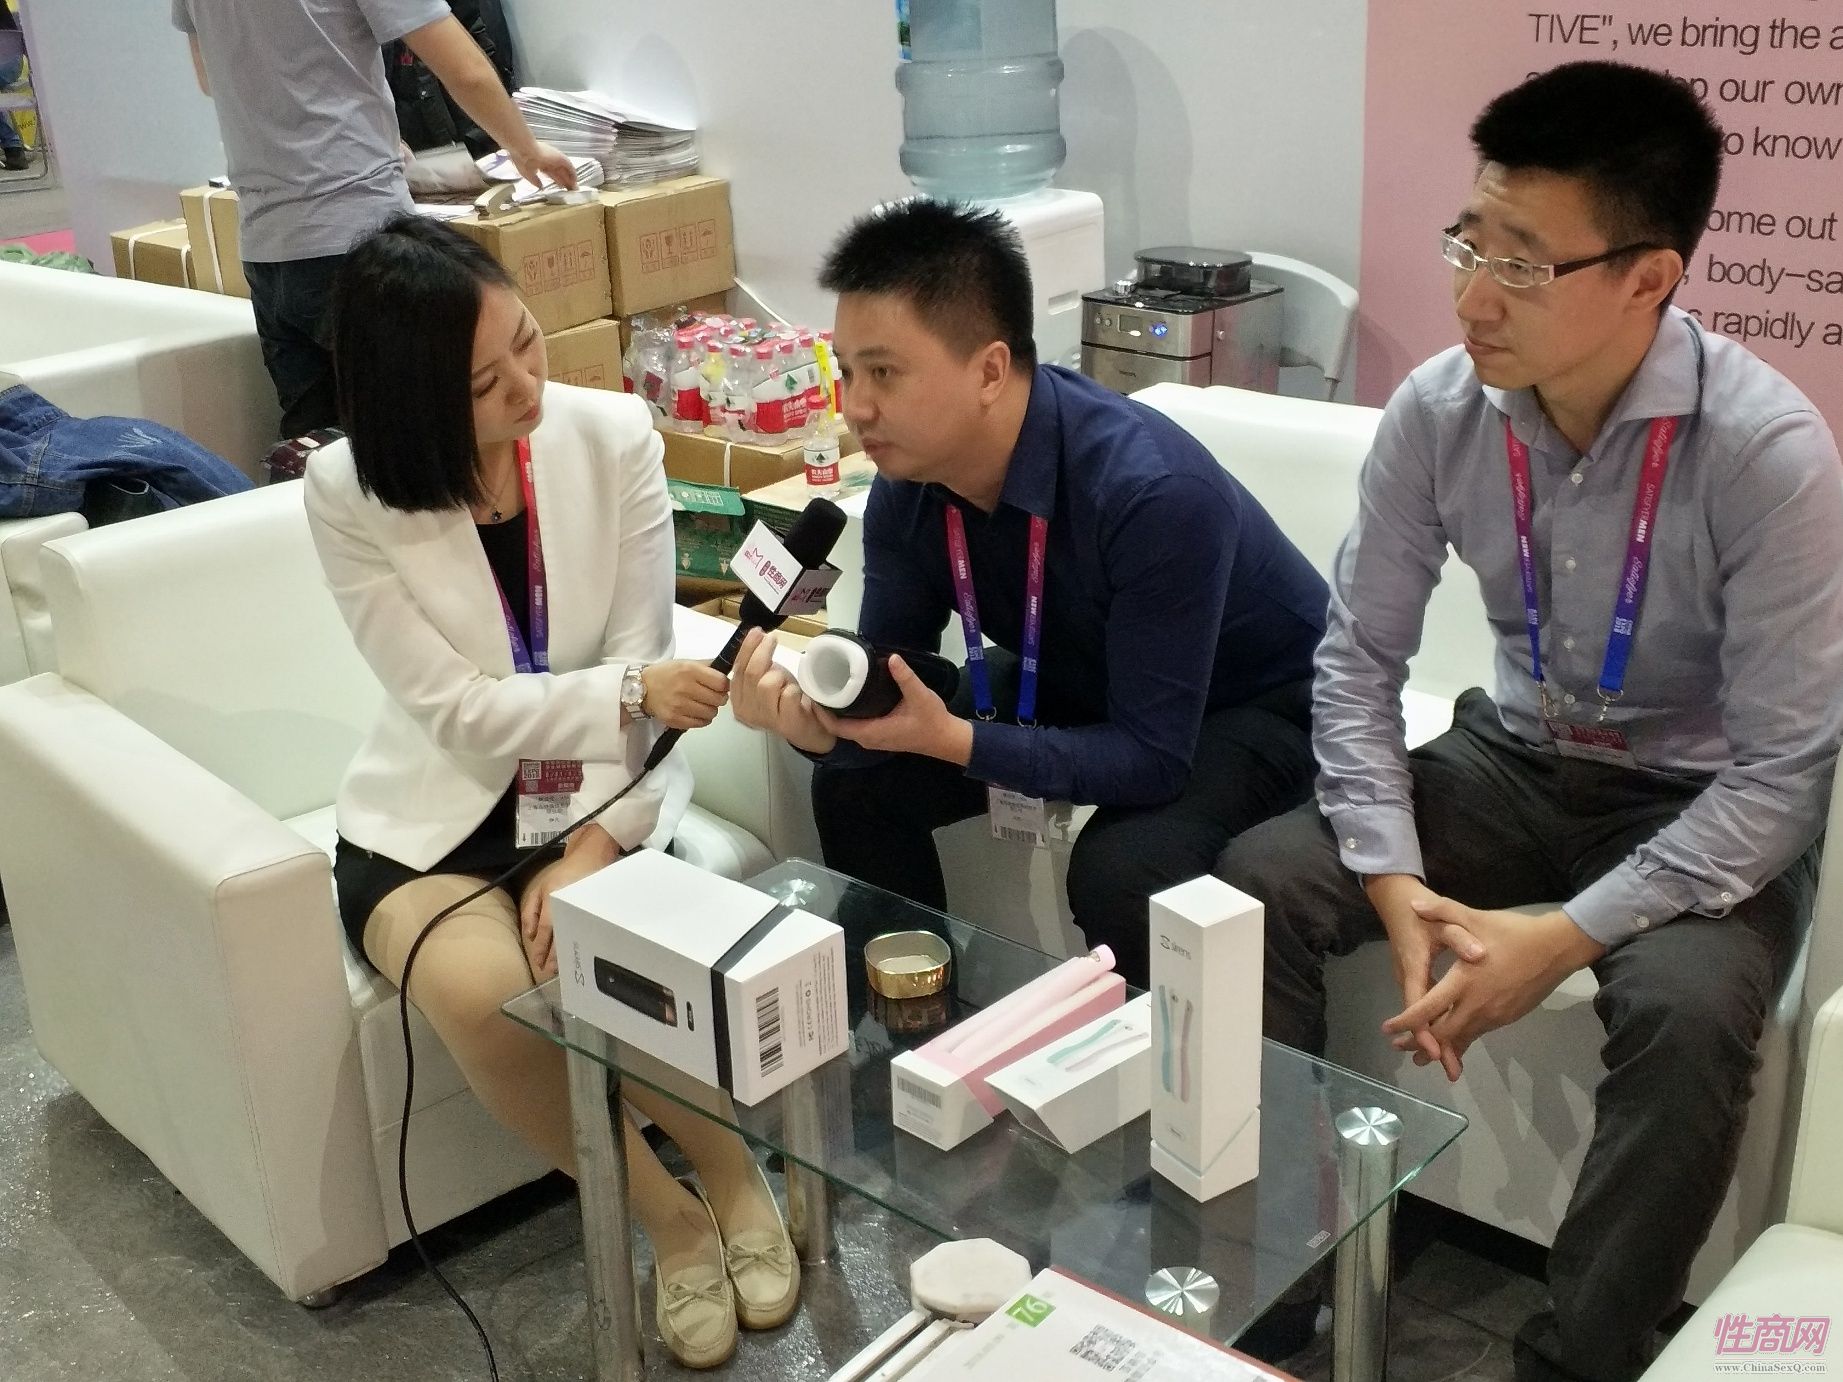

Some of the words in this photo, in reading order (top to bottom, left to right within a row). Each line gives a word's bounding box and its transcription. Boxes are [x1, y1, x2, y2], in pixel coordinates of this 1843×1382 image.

[1528, 13, 1618, 51] TIVE",
[1628, 22, 1673, 47] we
[1681, 16, 1761, 55] bring
[1768, 17, 1821, 50] the
[1719, 78, 1775, 103] our
[1753, 126, 1843, 160] know
[1707, 209, 1776, 236] ome
[1785, 212, 1838, 241] out
[1712, 309, 1815, 348] rapidly
